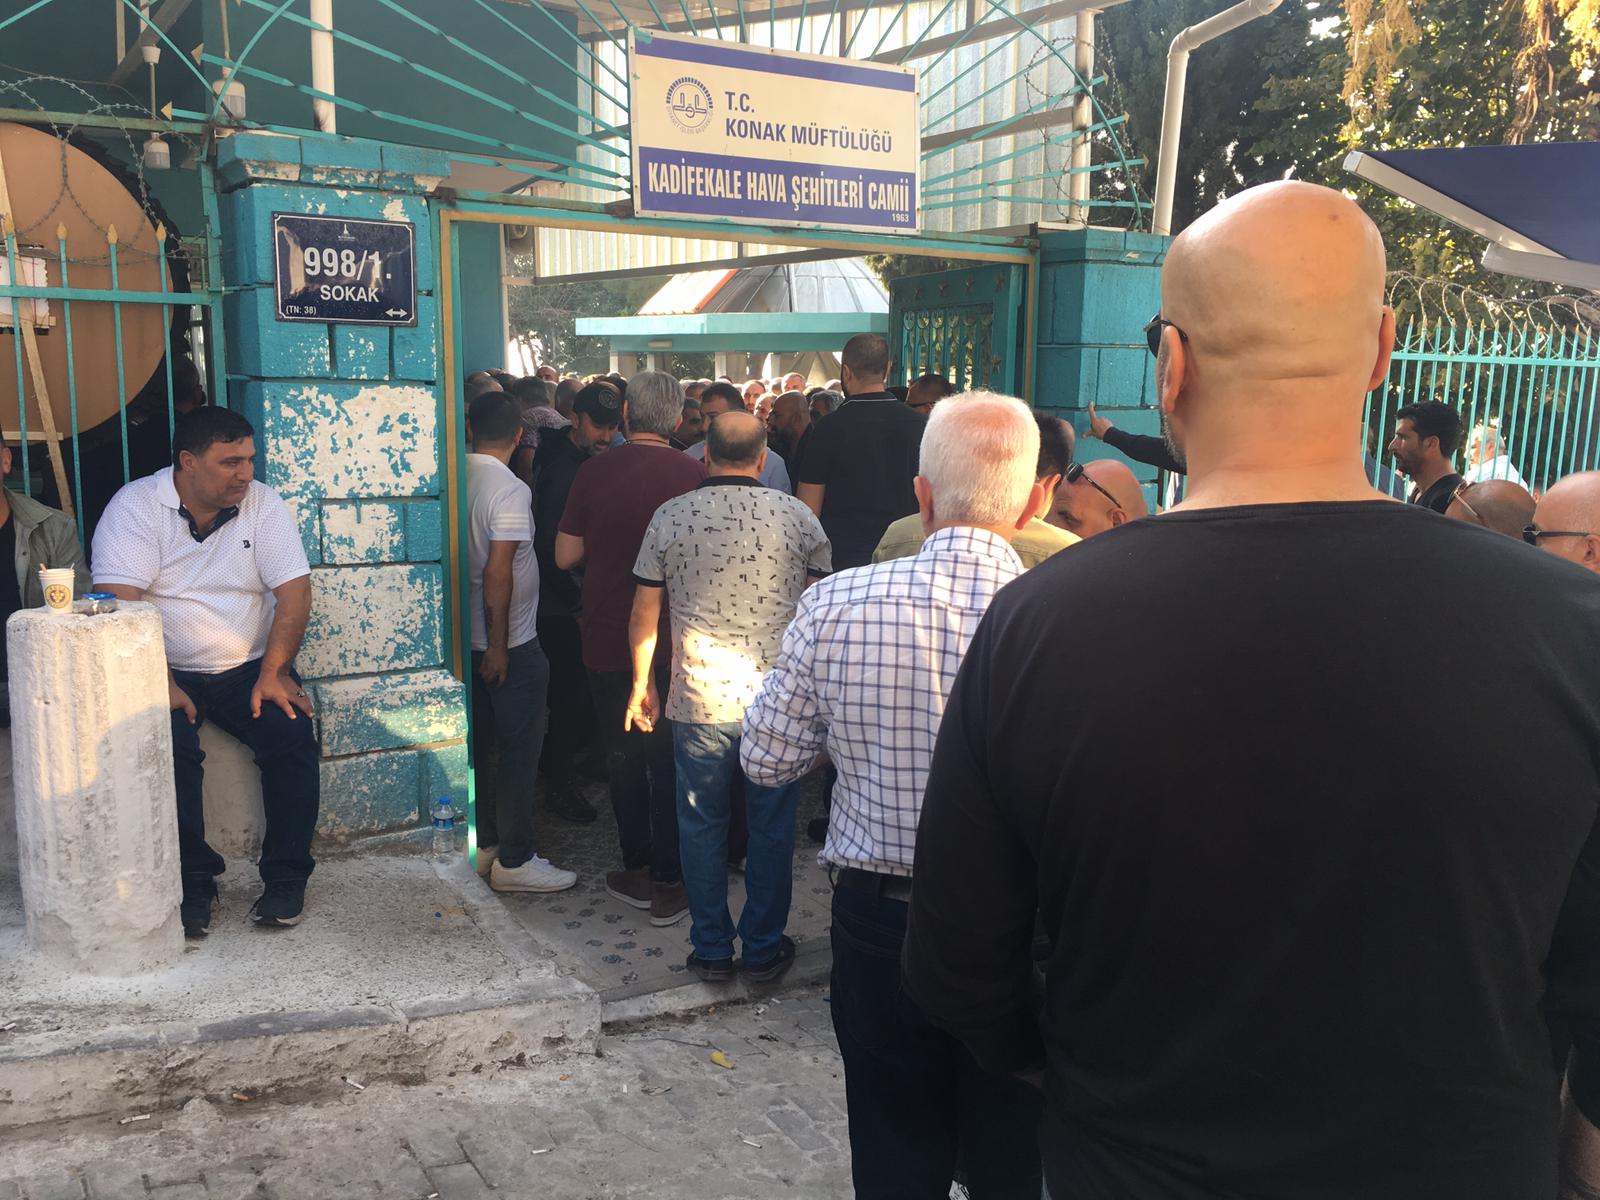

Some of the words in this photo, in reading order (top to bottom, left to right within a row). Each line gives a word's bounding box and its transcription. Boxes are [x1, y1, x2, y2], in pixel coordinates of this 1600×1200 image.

[725, 91, 755, 113] T.C.
[725, 118, 786, 142] KONAK
[791, 122, 892, 153] MÜFTÜLÜĞÜ
[648, 158, 742, 199] KADİFEKALE
[747, 171, 787, 203] HAVA
[791, 171, 863, 211] ŞEHİTLERİ
[868, 178, 909, 212] CAMİİ
[892, 213, 909, 222] 1963
[320, 285, 379, 303] SOKAK
[285, 305, 302, 315] (TN:
[303, 305, 317, 315] 38)
